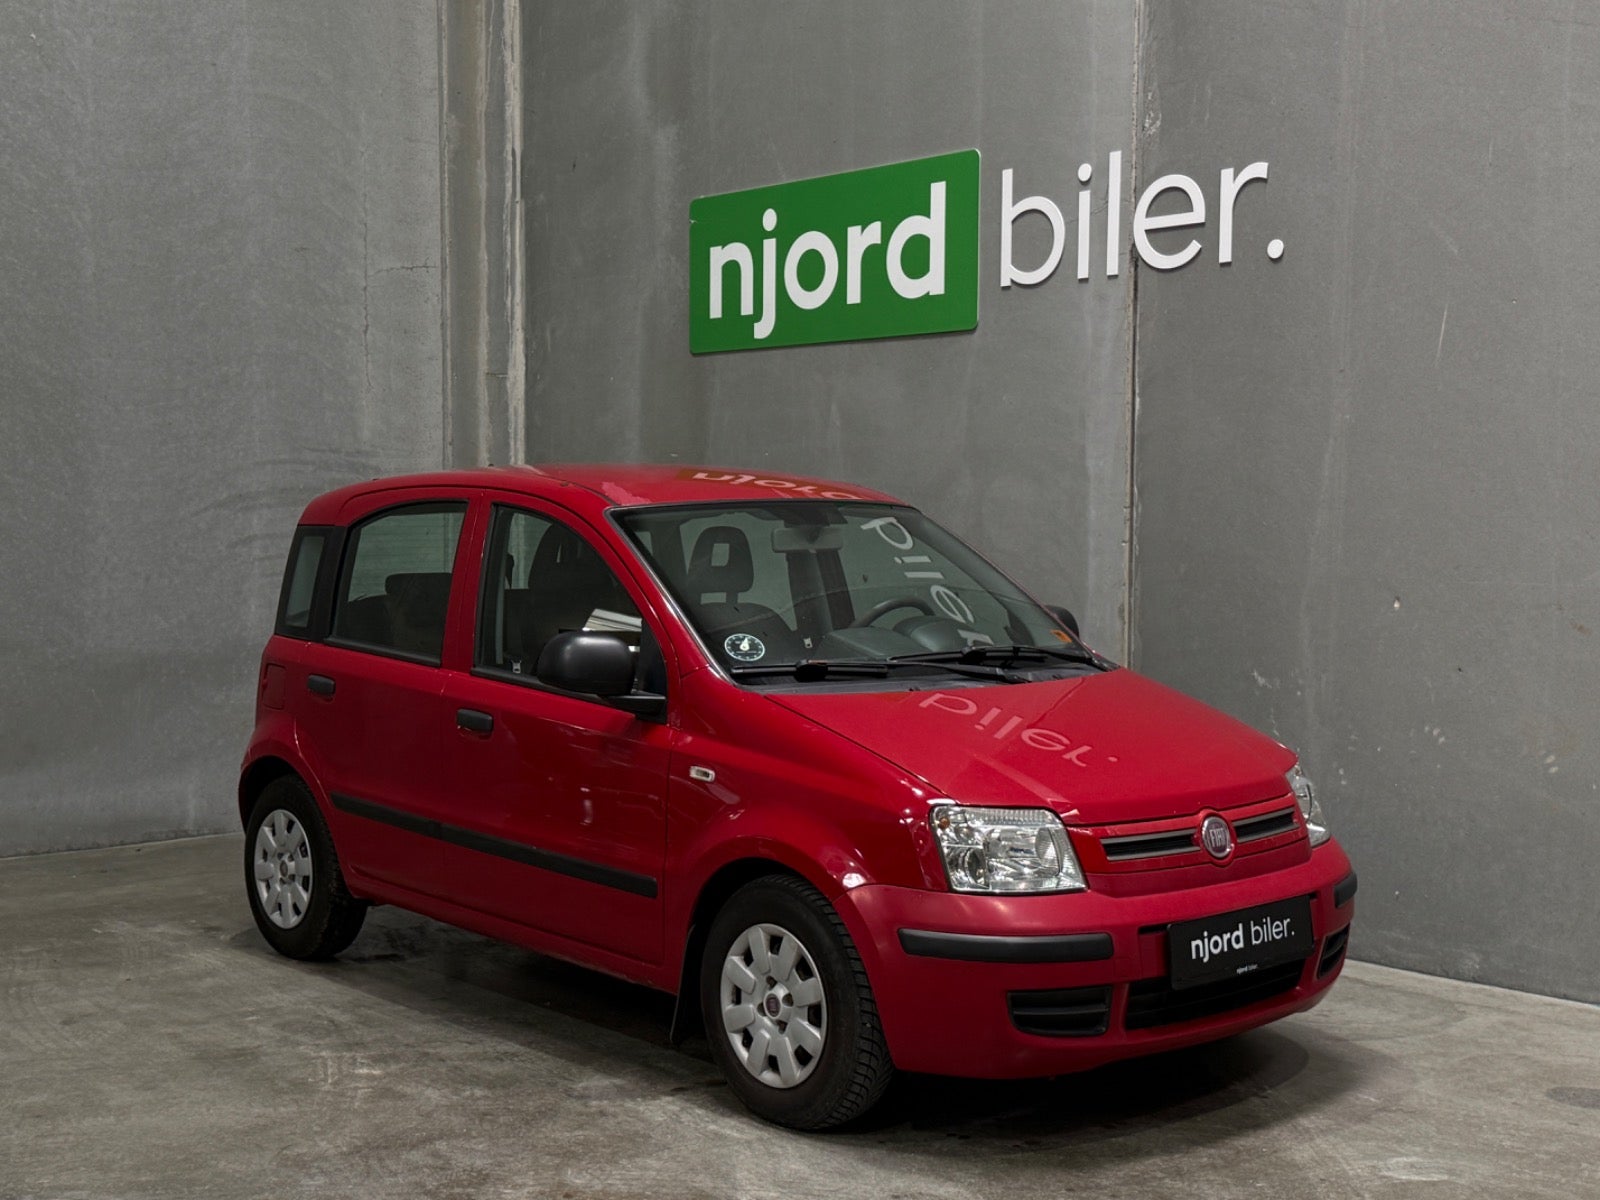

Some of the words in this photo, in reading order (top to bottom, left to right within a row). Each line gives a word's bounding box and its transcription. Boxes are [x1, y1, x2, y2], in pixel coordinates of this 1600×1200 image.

[709, 181, 946, 340] njord
[1000, 150, 1285, 288] biler.
[1191, 923, 1244, 962] njord
[1251, 917, 1294, 945] biler.
